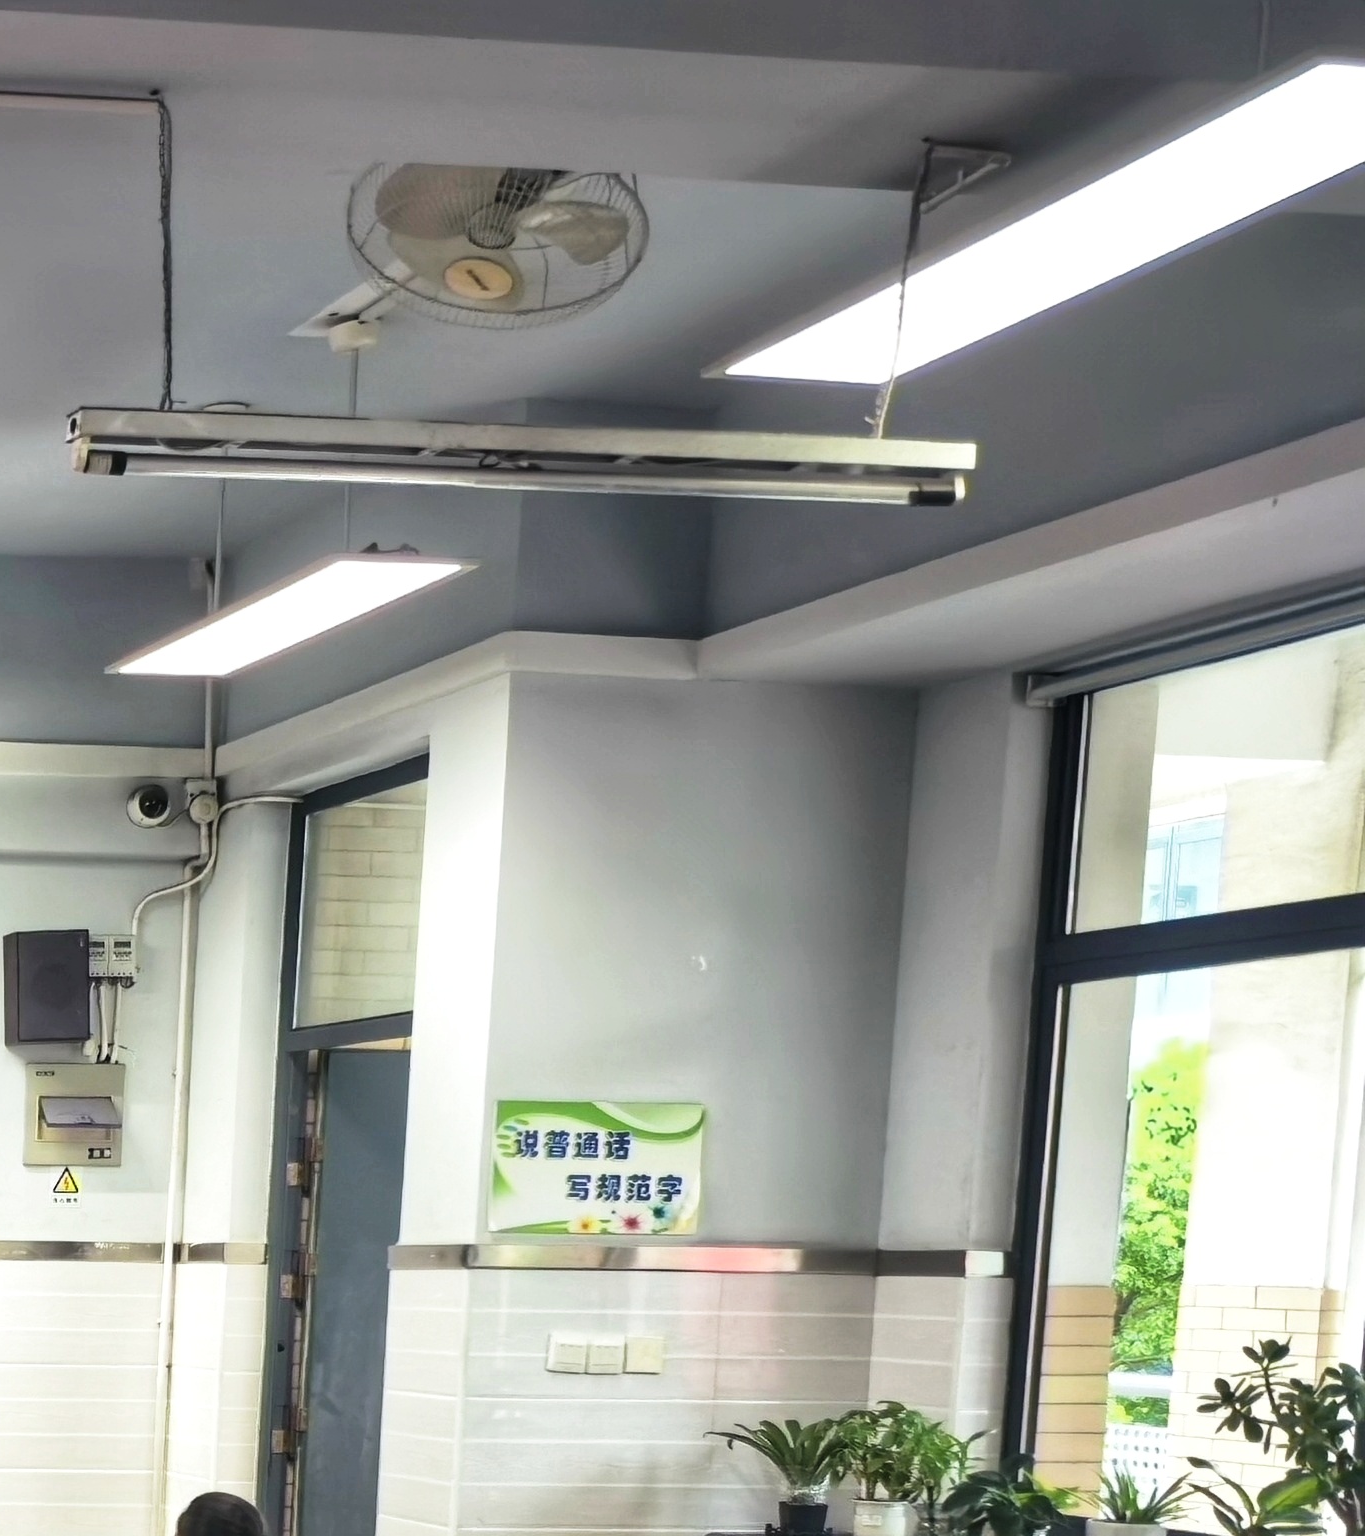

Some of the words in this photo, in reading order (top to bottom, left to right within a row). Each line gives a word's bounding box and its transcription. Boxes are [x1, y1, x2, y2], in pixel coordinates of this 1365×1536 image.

[515, 1130, 632, 1160] 说普通话
[566, 1174, 684, 1203] 写规范字
